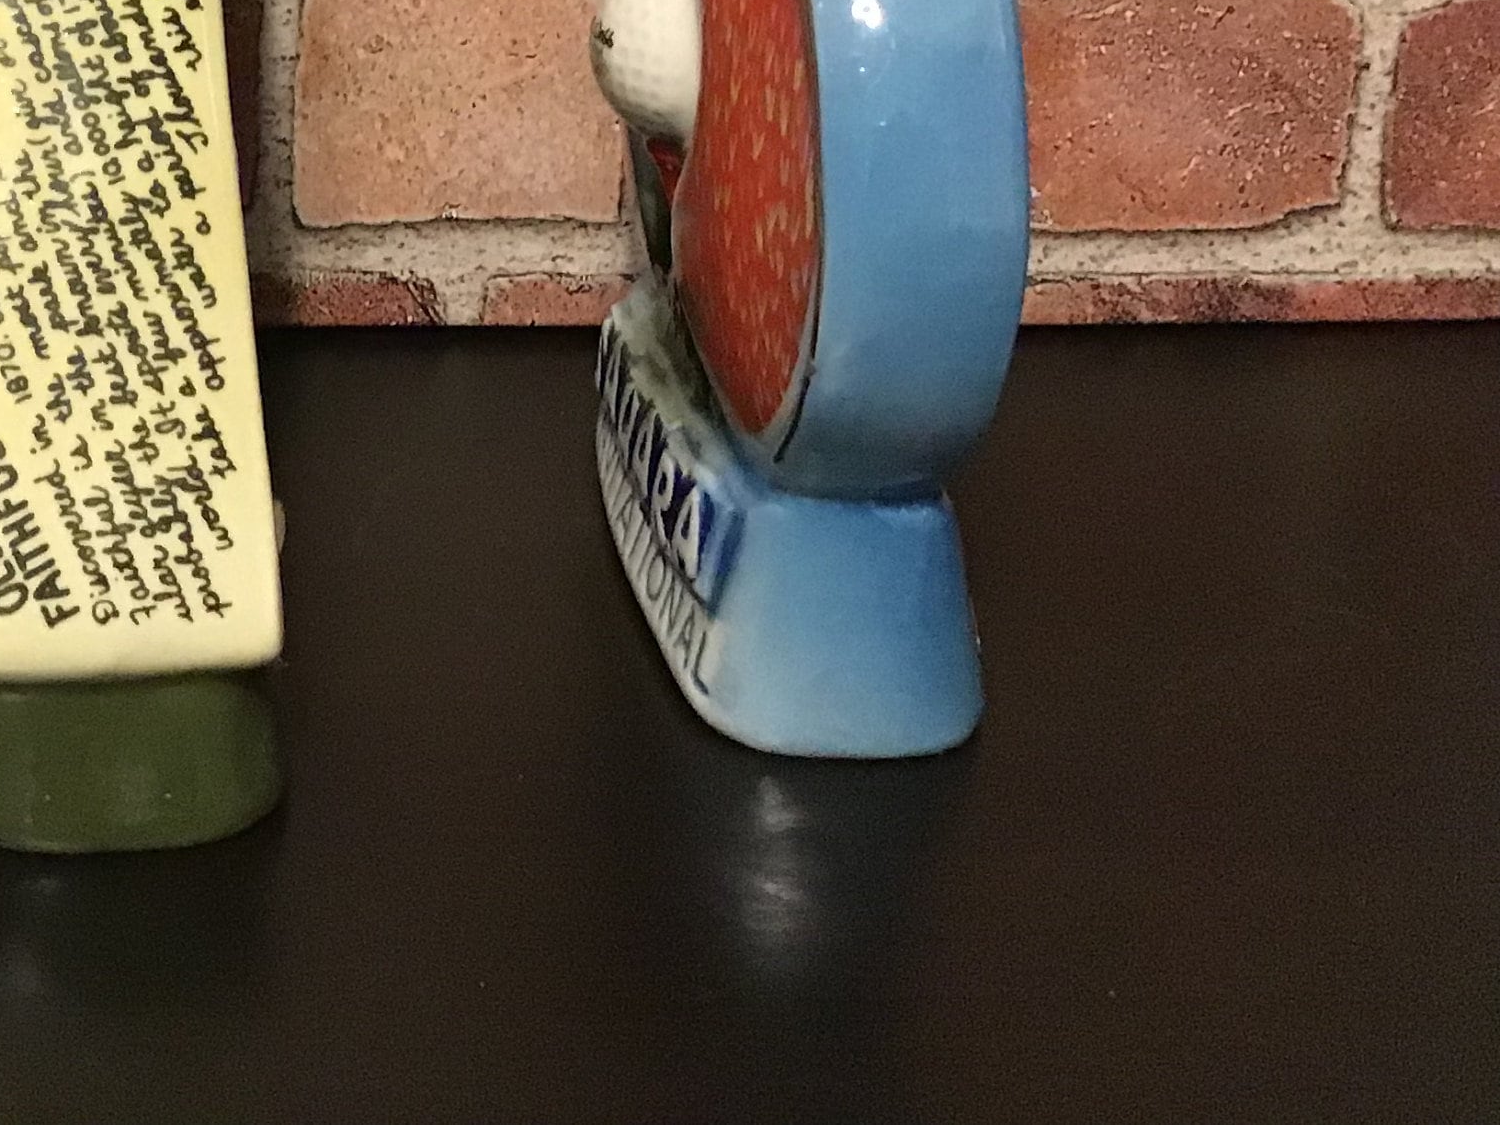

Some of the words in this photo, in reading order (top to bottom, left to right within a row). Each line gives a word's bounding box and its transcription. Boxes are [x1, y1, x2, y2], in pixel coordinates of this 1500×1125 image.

[64, 19, 99, 47] of
[162, 6, 202, 72] this
[81, 54, 143, 150] height
[124, 70, 152, 98] of
[42, 88, 83, 156] and
[136, 106, 206, 200] period
[13, 149, 41, 200] the
[137, 150, 155, 173] a
[36, 200, 61, 234] in
[148, 181, 171, 219] to
[195, 211, 211, 236] a
[30, 260, 83, 334] park
[51, 238, 109, 338] known
[118, 191, 226, 392] approximately
[170, 227, 217, 309] water
[5, 284, 51, 360] most
[143, 310, 187, 365] few
[46, 373, 72, 424] the
[65, 345, 95, 397] the
[91, 342, 138, 409] best
[178, 375, 196, 397] a
[30, 413, 53, 454] in
[90, 399, 114, 431] in
[130, 417, 160, 465] the
[192, 404, 237, 479] take
[70, 434, 93, 472] is
[104, 439, 166, 539] geyser
[33, 458, 120, 626] Discovered
[83, 485, 157, 625] Faithful
[150, 470, 232, 618] probably
[153, 545, 194, 623] ular
